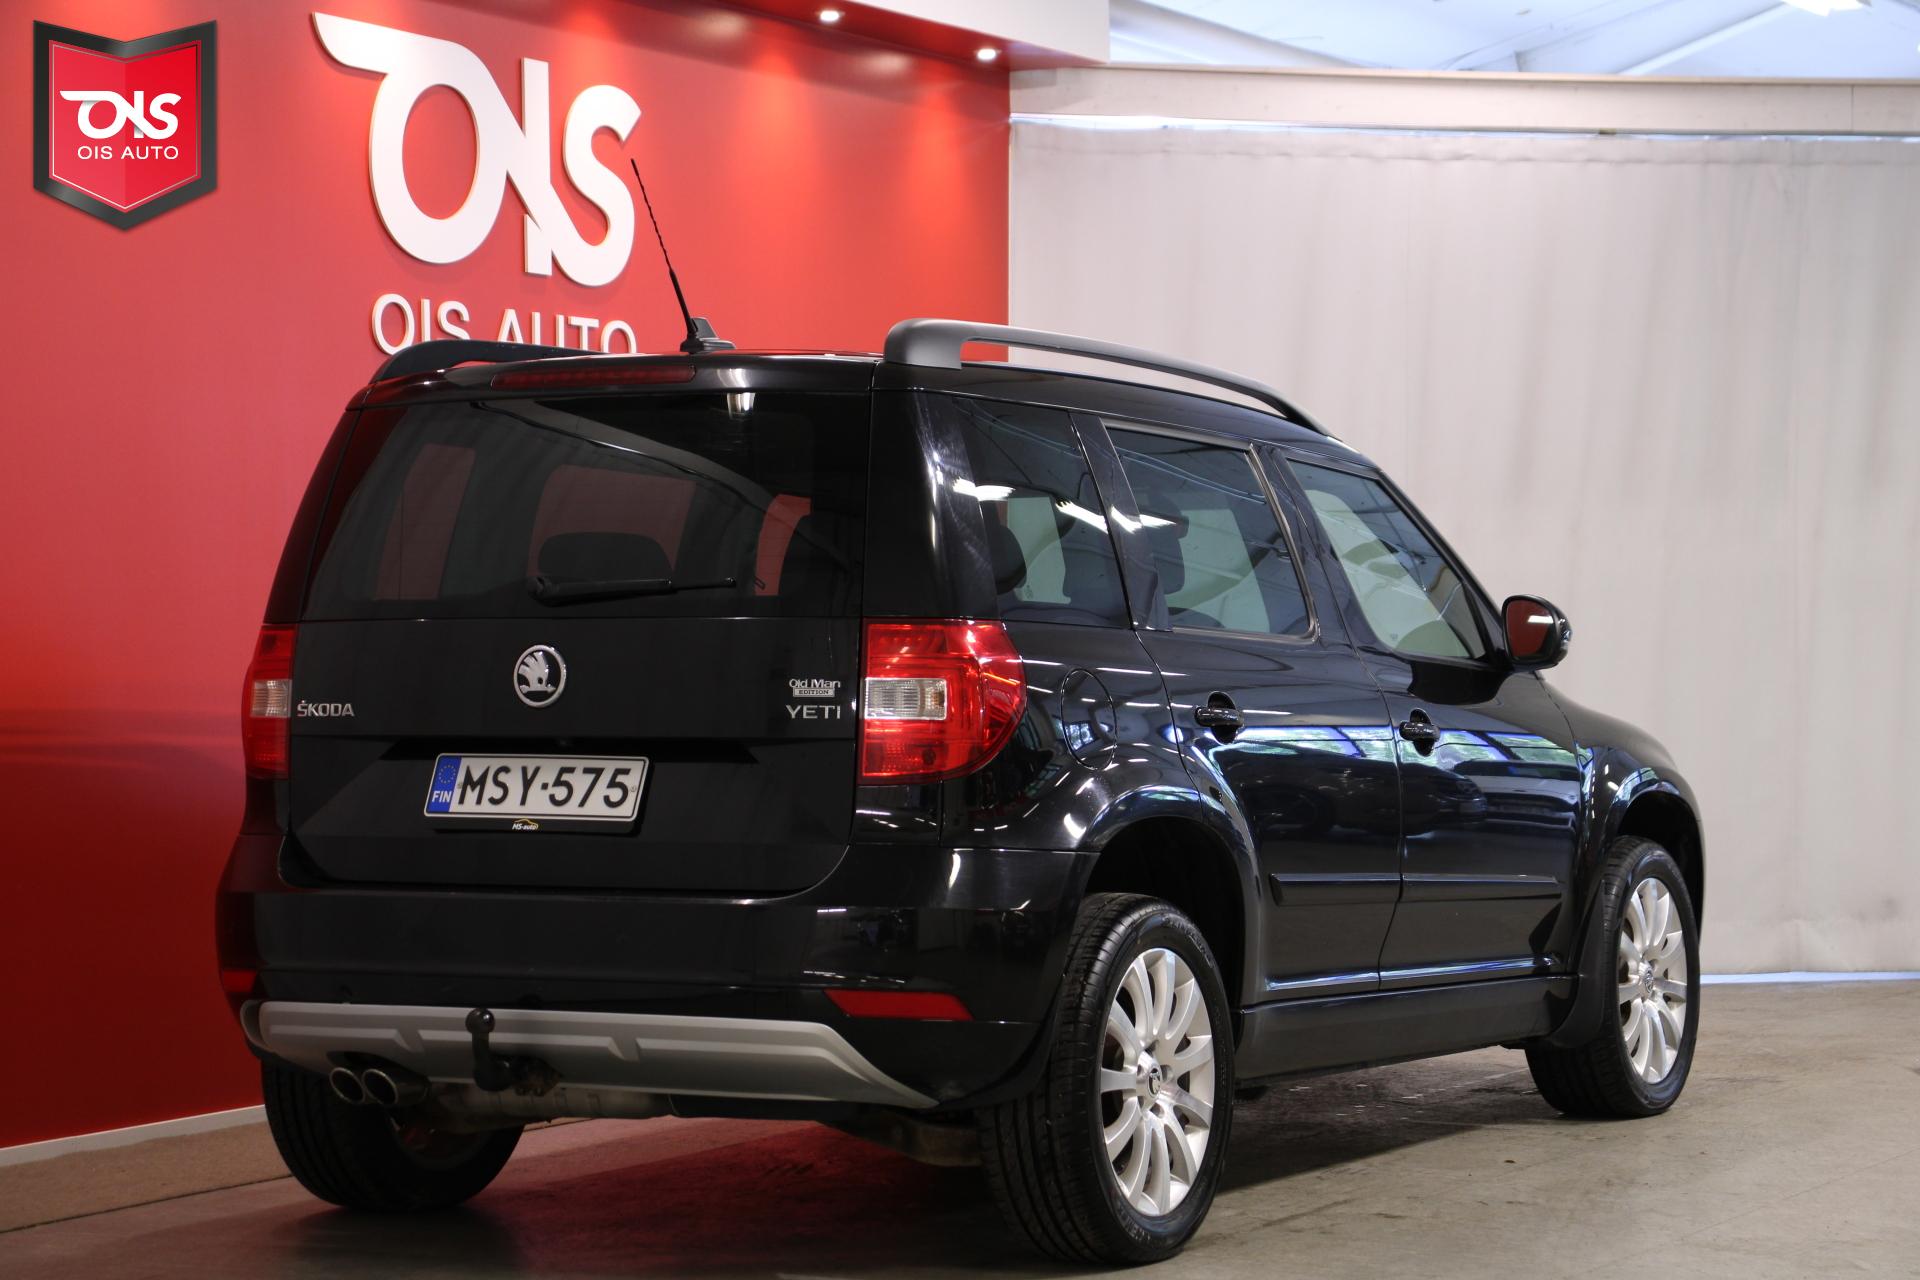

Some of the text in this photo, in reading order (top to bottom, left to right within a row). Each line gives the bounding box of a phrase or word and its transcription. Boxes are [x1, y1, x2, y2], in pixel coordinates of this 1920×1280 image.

[313, 12, 641, 286] OIS
[372, 293, 637, 356] OIS AUTO
[789, 678, 841, 688] Old Man
[297, 700, 355, 717] ŠKODA
[785, 704, 841, 719] YETI
[457, 765, 632, 809] MSY-575
[431, 790, 452, 803] FIN
